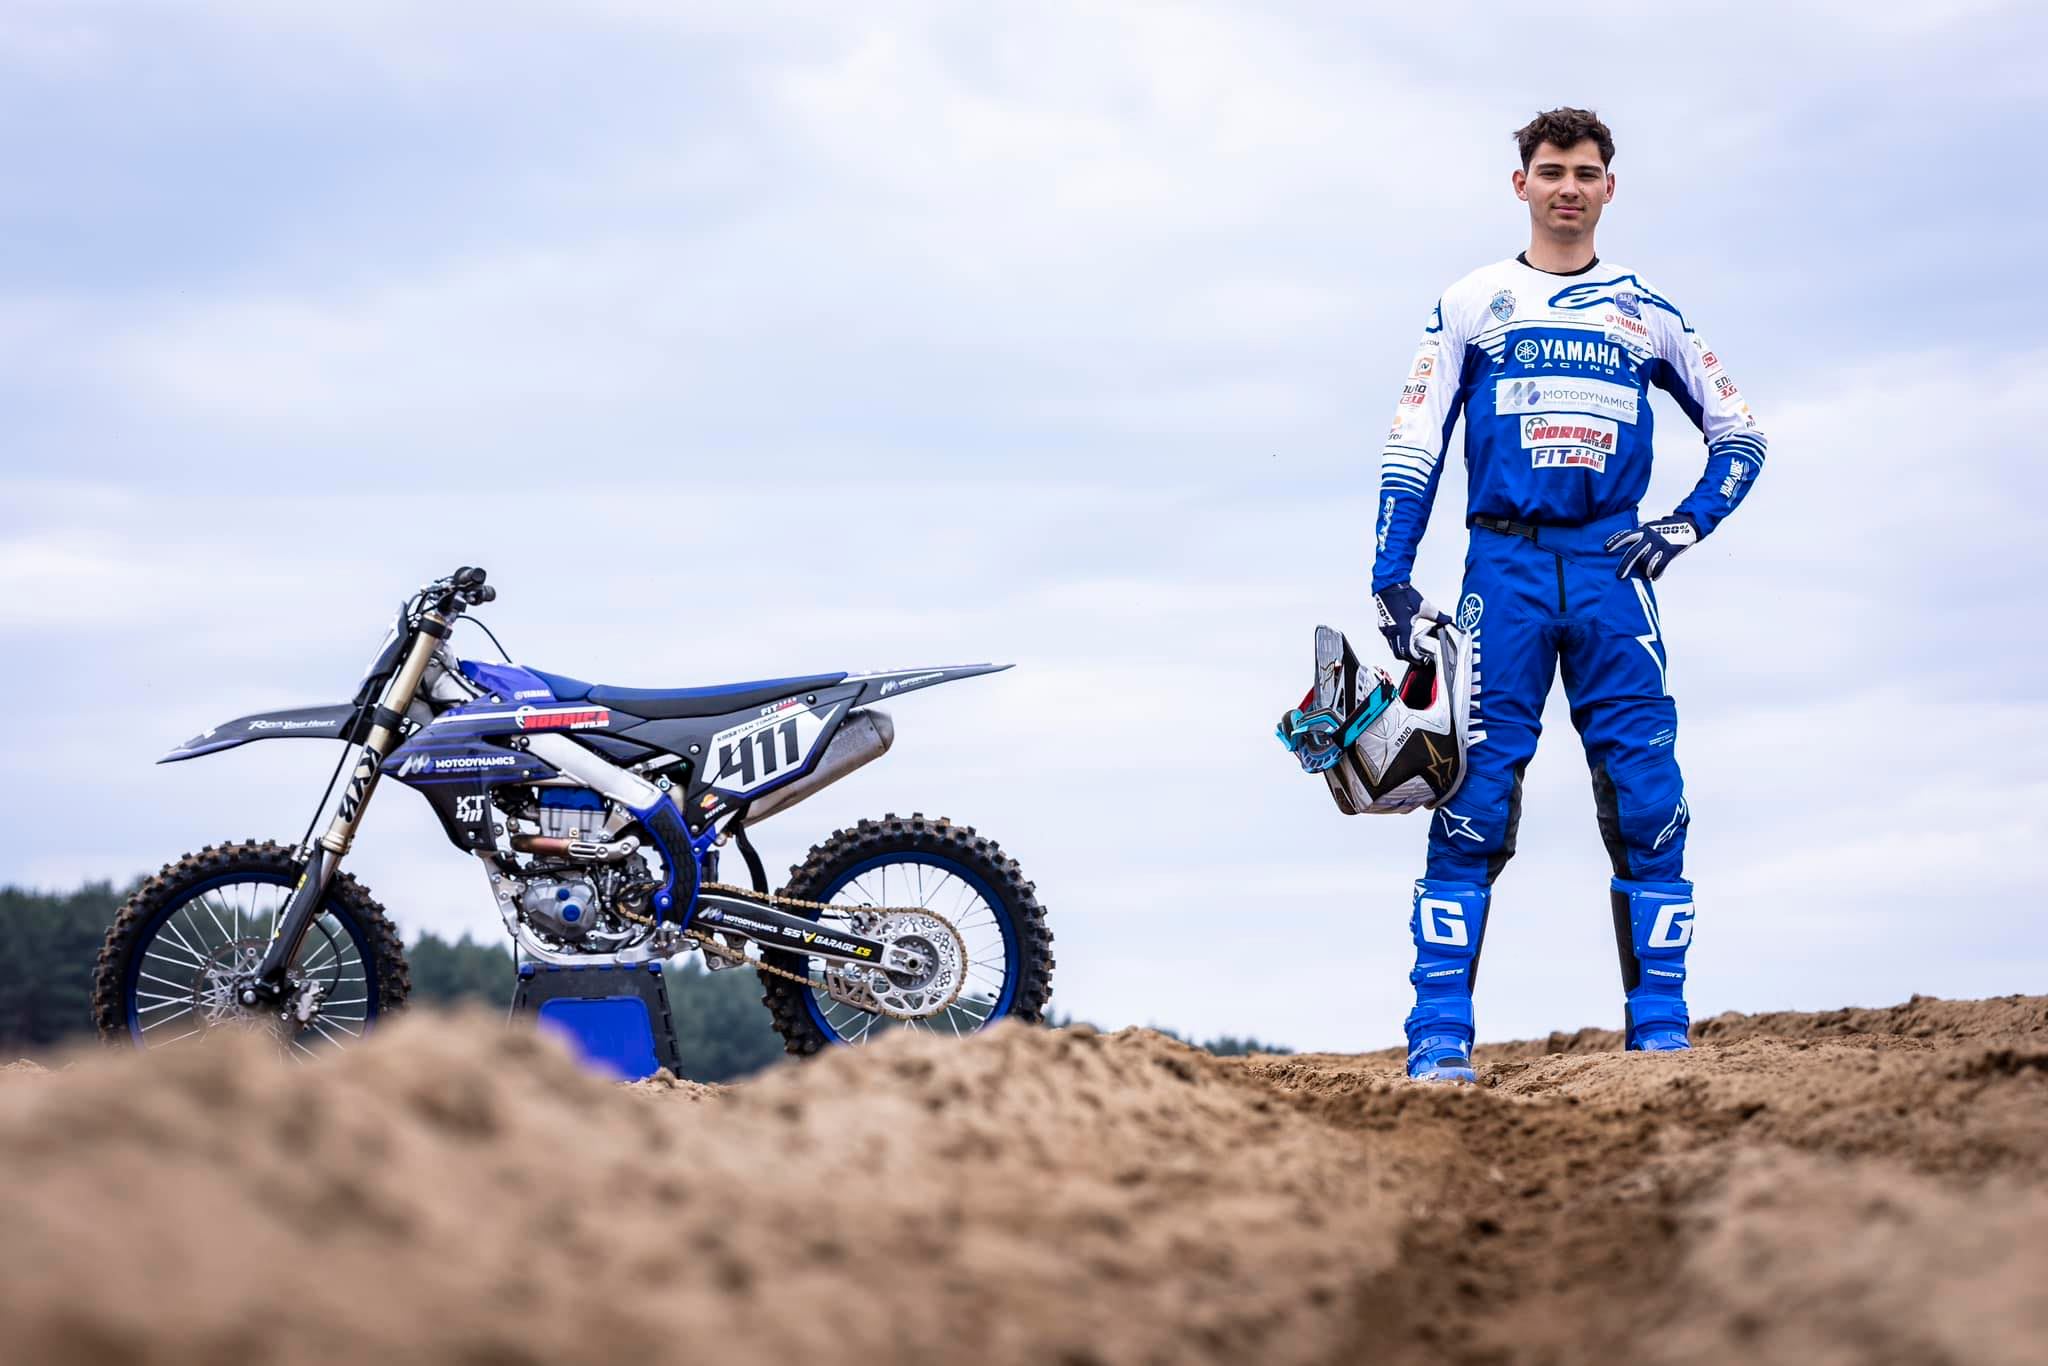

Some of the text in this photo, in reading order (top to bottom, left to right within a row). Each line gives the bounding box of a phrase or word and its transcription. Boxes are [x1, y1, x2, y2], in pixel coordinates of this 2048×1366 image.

[1615, 315, 1648, 337] YAMAHA
[1539, 338, 1621, 369] YAMAHA
[1524, 361, 1615, 376] RACING
[1542, 389, 1636, 412] MOTODYNAMICS
[1532, 425, 1613, 444] NORDICA
[1534, 449, 1572, 465] FIT
[435, 756, 516, 769] MOTODYNAMICS
[719, 717, 800, 787] 411
[456, 795, 486, 810] KT
[722, 914, 778, 934] MOTODYNAMICS
[1420, 897, 1469, 948] G
[1647, 901, 1694, 949] G
